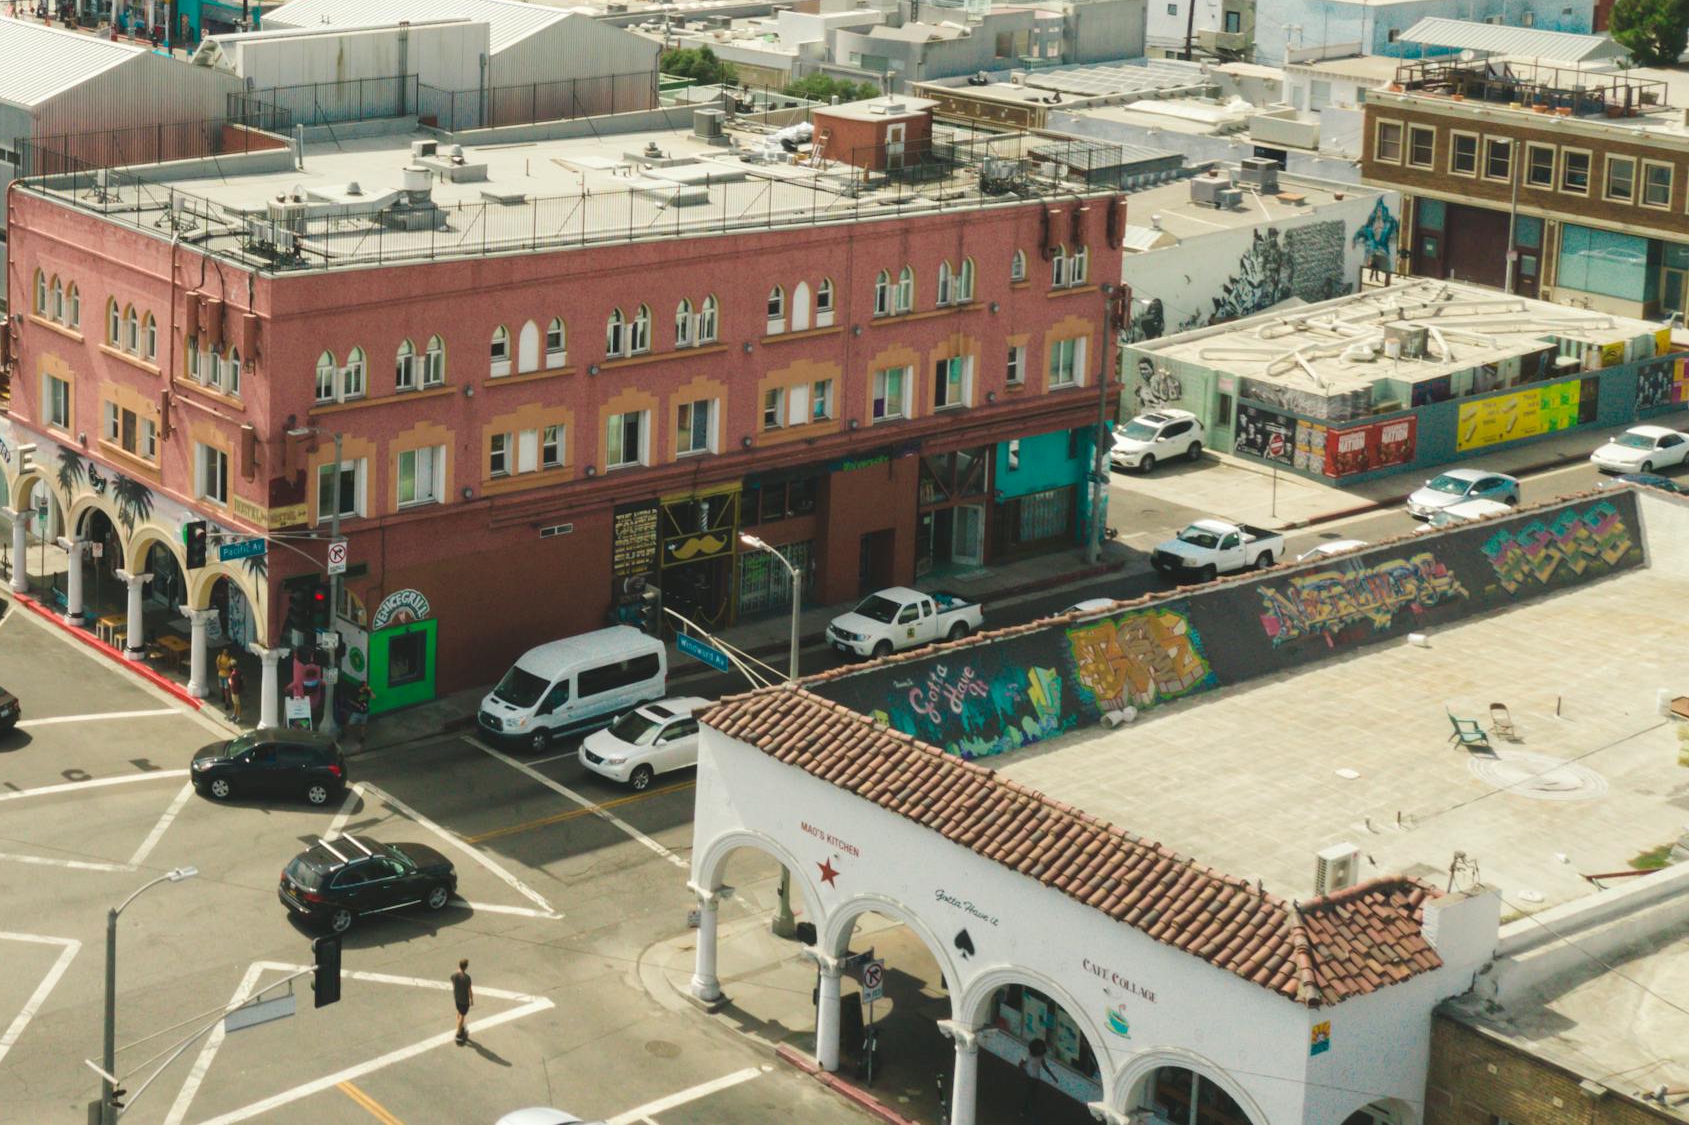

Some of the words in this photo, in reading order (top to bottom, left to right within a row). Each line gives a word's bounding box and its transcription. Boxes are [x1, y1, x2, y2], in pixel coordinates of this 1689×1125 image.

[223, 545, 250, 557] Pacific
[680, 638, 714, 661] Windward
[800, 821, 825, 840] MAO'S
[826, 834, 860, 857] KITCHEN
[935, 889, 962, 908] Gotta
[963, 901, 989, 922] Have
